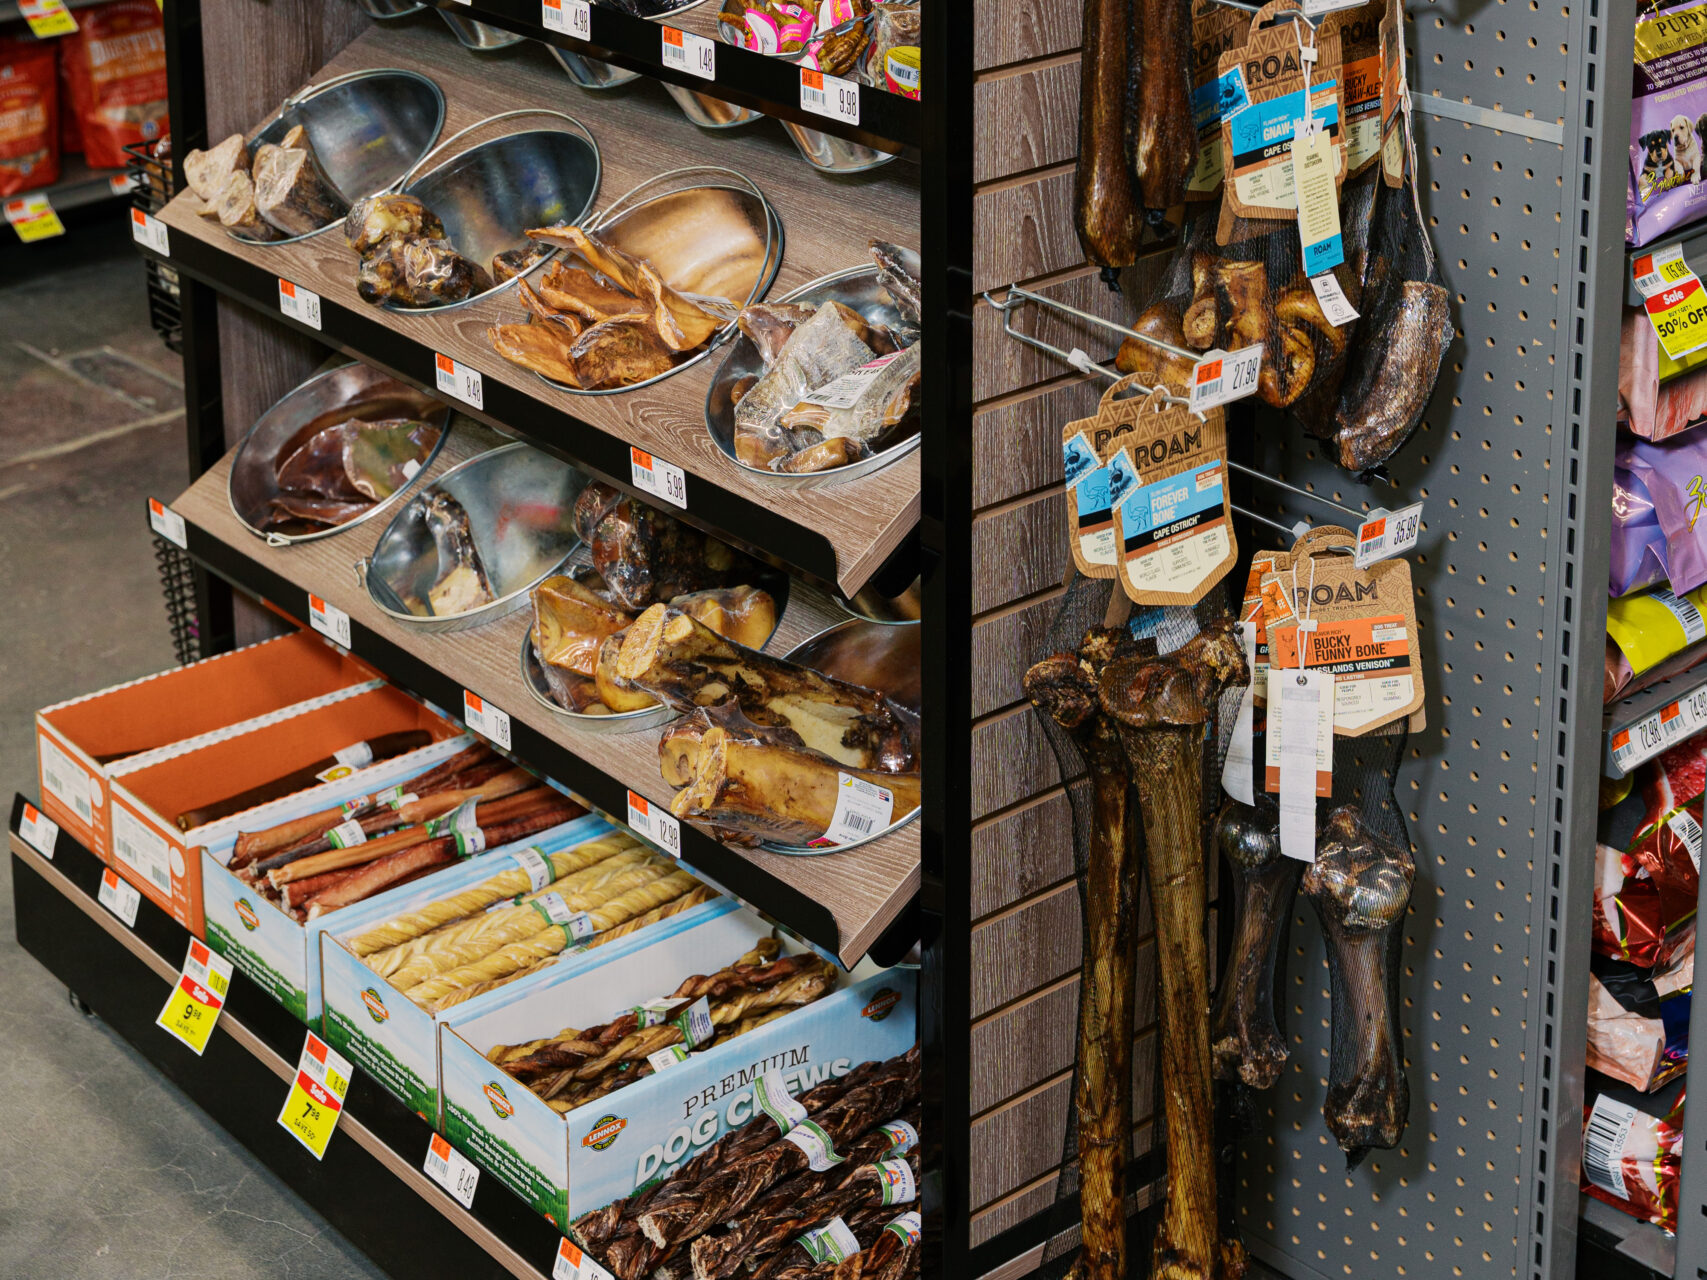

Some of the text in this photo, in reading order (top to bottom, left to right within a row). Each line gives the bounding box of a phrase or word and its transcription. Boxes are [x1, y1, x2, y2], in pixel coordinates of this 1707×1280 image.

[572, 10, 589, 33] 4.98
[1656, 8, 1707, 37] PUPPY
[698, 47, 713, 73] 1.48
[838, 88, 858, 117] 9.98
[1263, 145, 1281, 158] CAPE
[1642, 170, 1694, 202] Zignature
[1313, 241, 1332, 257] ROAM
[1666, 261, 1690, 280] 15.98
[1663, 289, 1685, 305] Sale
[1657, 314, 1688, 338] 50%
[1232, 358, 1258, 390] 27.98
[466, 375, 482, 403] 8.48
[1134, 431, 1202, 471] ROAM
[666, 471, 684, 501] 5.98
[1151, 487, 1190, 511] FOREVER
[1152, 506, 1176, 526] BONE
[1153, 515, 1199, 540] CAPE OSTRICH
[1394, 515, 1419, 546] 35.98
[1292, 579, 1378, 609] ROAM
[1313, 635, 1351, 650] BUCKY
[1315, 643, 1386, 662] FUNNY BONE
[1355, 659, 1391, 670] VENISON
[495, 714, 510, 744] 7.98
[1638, 719, 1662, 752] 72.98
[659, 818, 679, 851] 12.98
[192, 985, 209, 1004] Sale
[309, 1083, 328, 1105] Sale
[683, 1044, 811, 1121] PREMIUM
[294, 1117, 308, 1134] SAVE
[589, 1122, 622, 1142] LENNOX
[634, 1110, 719, 1189] DOG
[457, 1167, 475, 1200] 8.48
